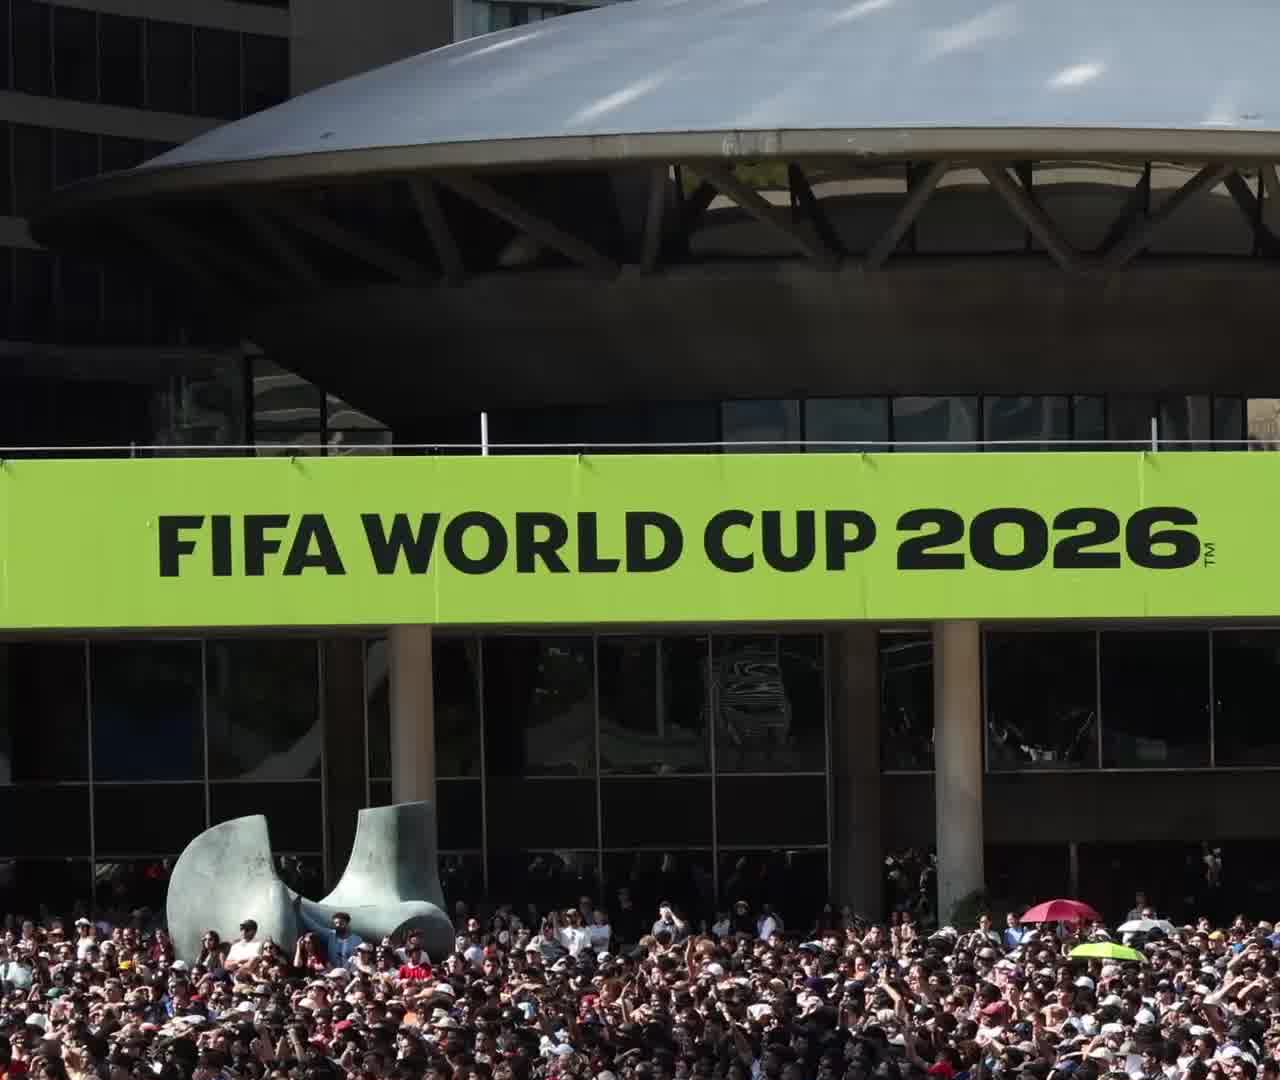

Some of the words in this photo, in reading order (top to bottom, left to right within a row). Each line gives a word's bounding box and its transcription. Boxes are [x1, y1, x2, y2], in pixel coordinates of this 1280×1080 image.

[158, 514, 346, 577] FIFA
[360, 511, 683, 574] WORLD
[704, 510, 876, 572] CUP
[896, 507, 1200, 570] 2026
